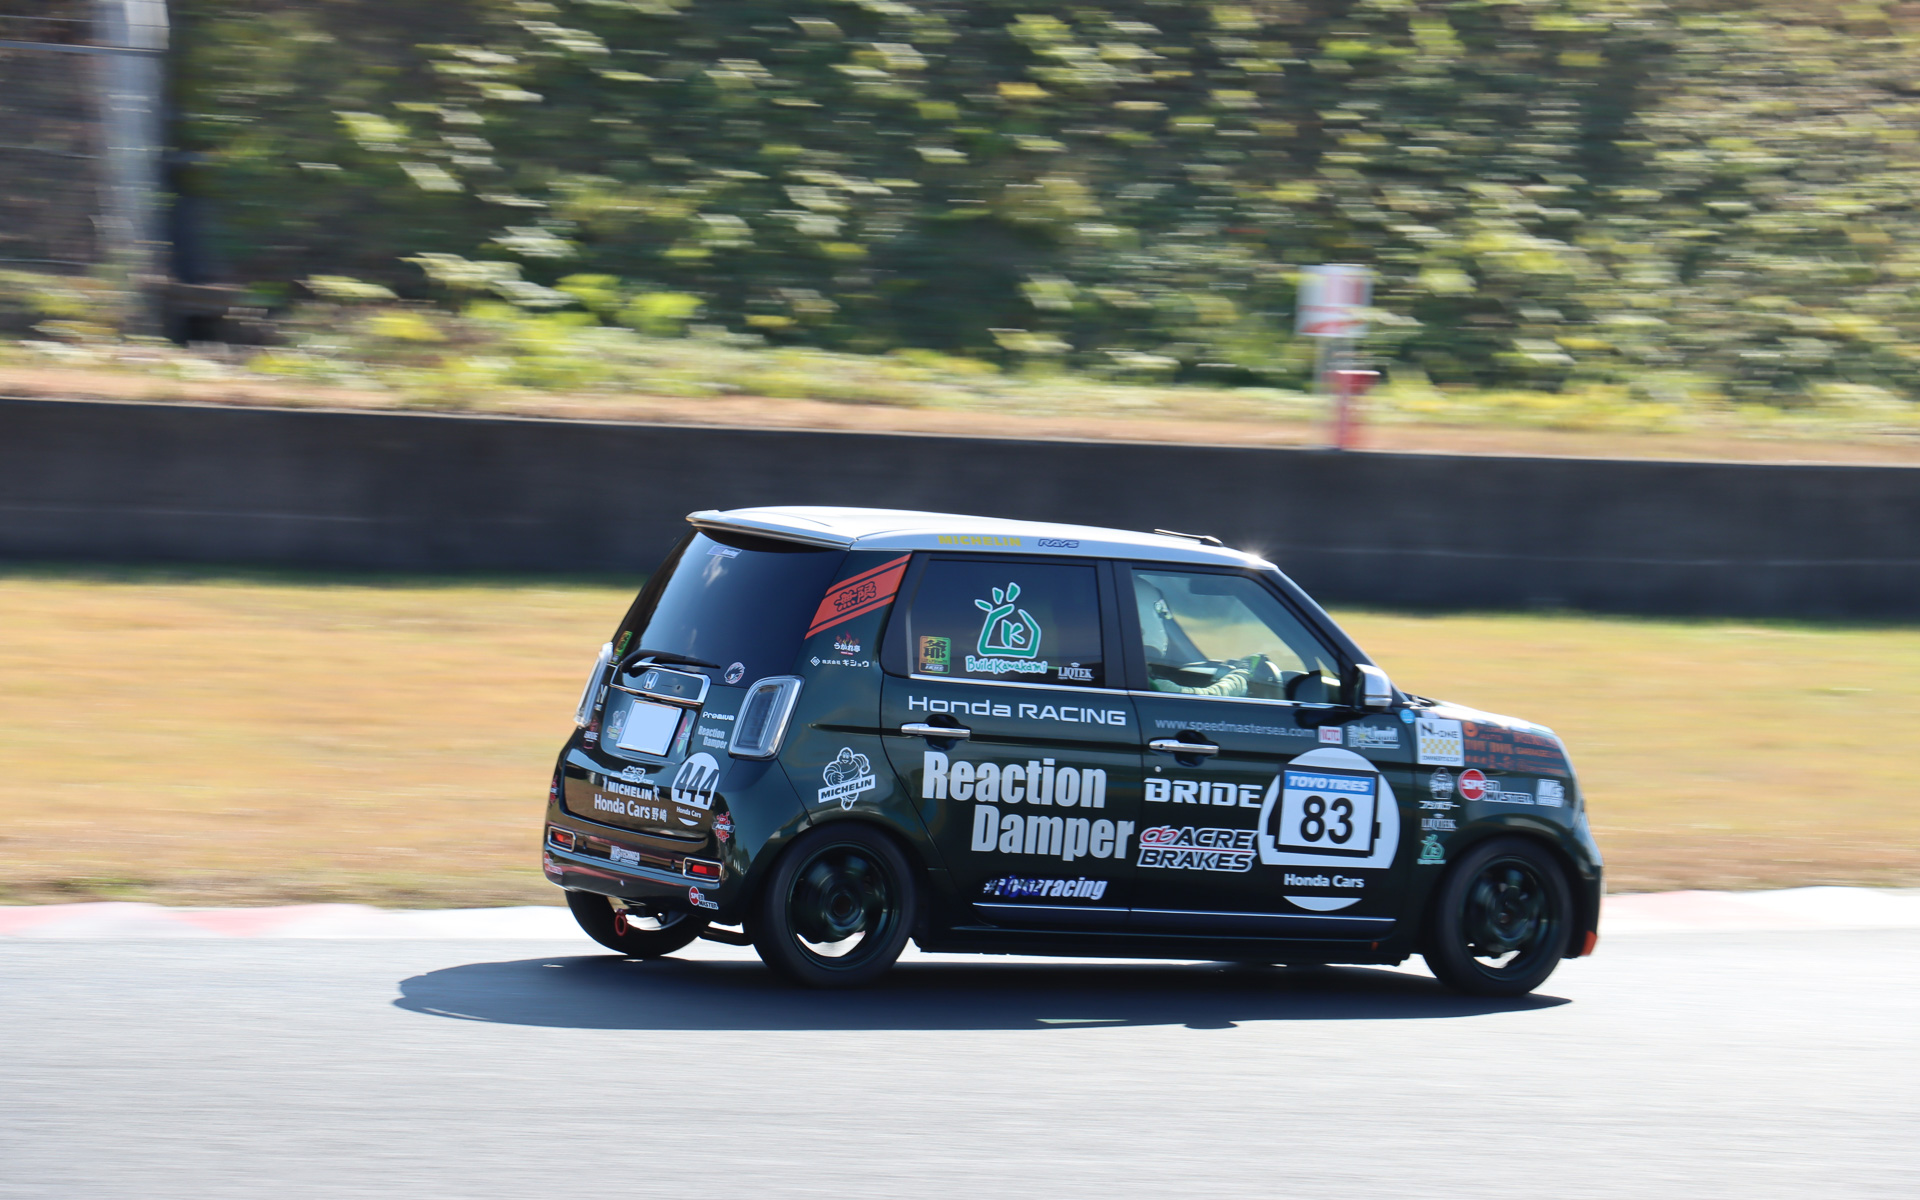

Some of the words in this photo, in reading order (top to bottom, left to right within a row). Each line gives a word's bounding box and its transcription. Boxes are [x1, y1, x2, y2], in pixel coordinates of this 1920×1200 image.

[938, 536, 1021, 546] MICHELIN
[1038, 538, 1079, 548] RAYS
[834, 581, 876, 612] 無限
[1058, 666, 1095, 679] LIQTEK
[908, 695, 1012, 718] Honda
[1018, 703, 1127, 726] RACING
[698, 725, 726, 739] Reaction
[1155, 718, 1316, 738] www.speedmastersea.com
[703, 737, 728, 750] Damper
[820, 778, 872, 800] MICHELIN
[922, 751, 1107, 808] Reaction
[1289, 775, 1328, 790] TOYO
[1328, 778, 1370, 792] TIRES
[608, 781, 653, 801] MICHELIN
[1144, 777, 1264, 808] BRIDE
[594, 793, 625, 815] Honda
[627, 800, 651, 819] Cars
[676, 806, 691, 816] Honda
[691, 810, 702, 818] Cars
[1300, 795, 1354, 844] 83
[971, 804, 1135, 862] Damper
[1175, 827, 1257, 849] ACRE
[1138, 849, 1256, 872] BRAKES
[1284, 873, 1329, 887] Honda
[1333, 876, 1364, 888] Cars
